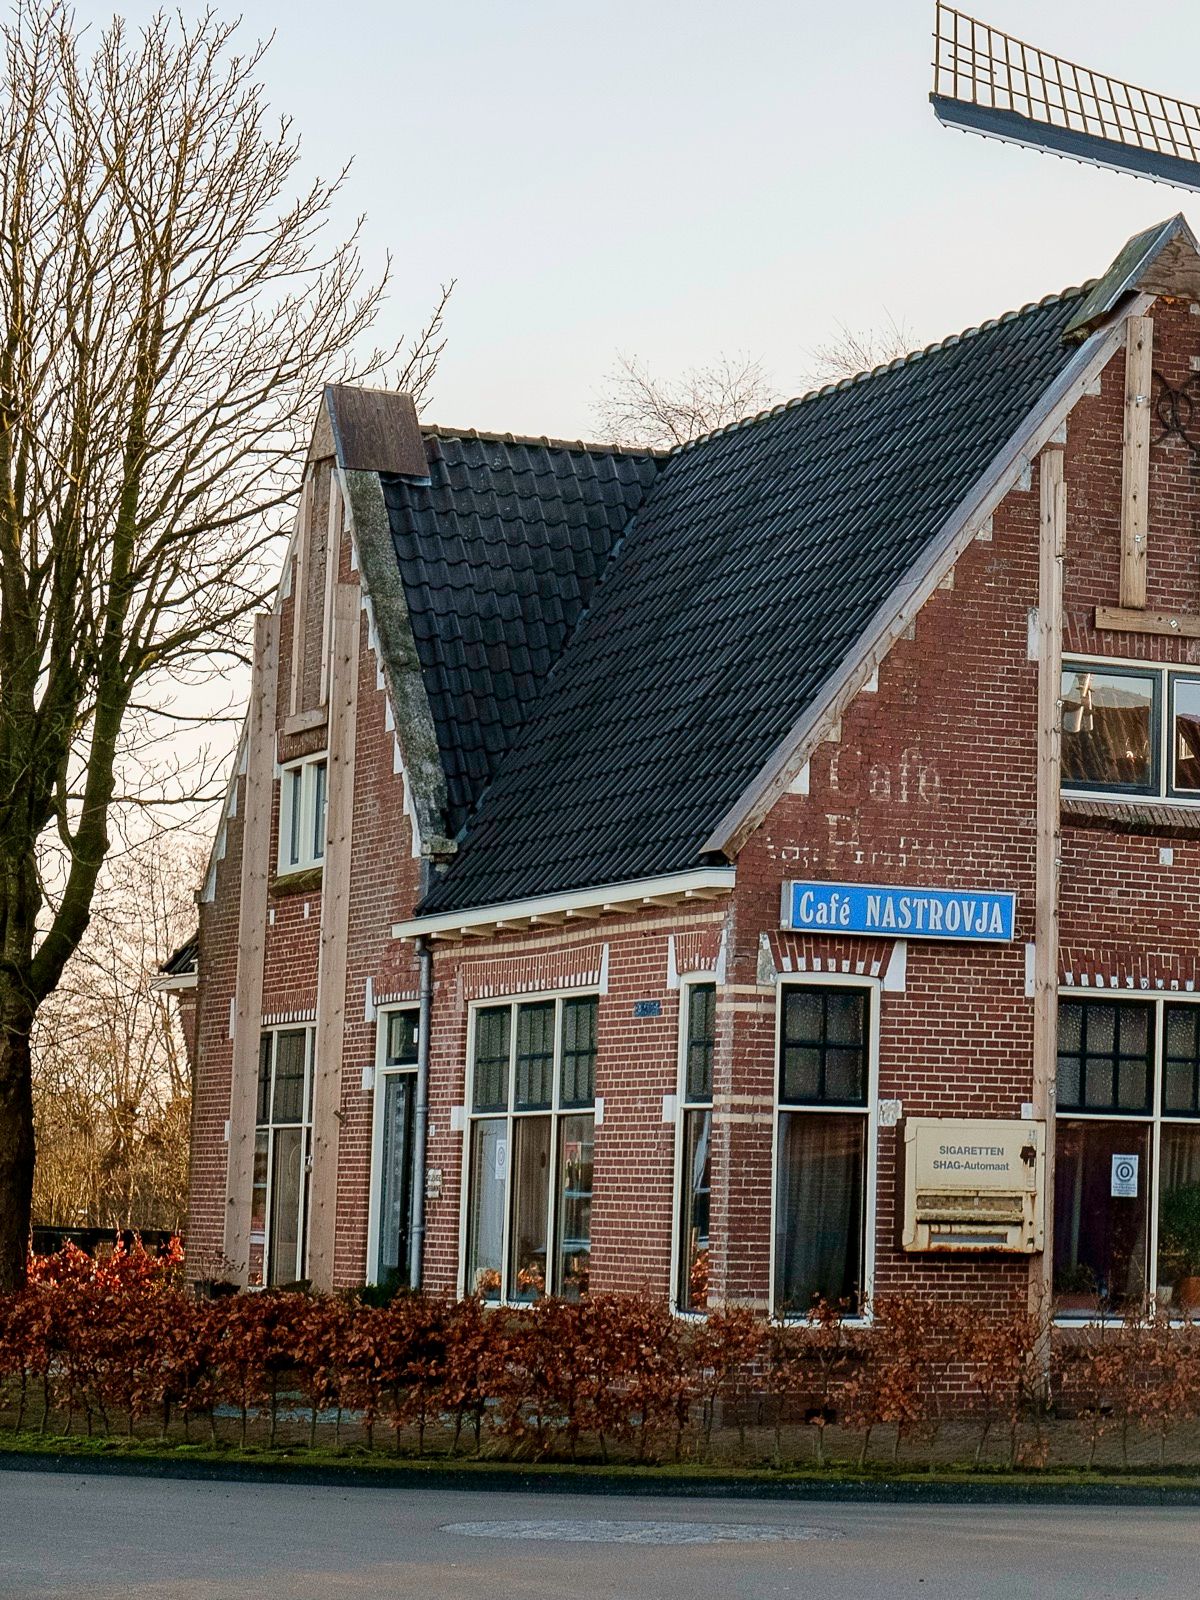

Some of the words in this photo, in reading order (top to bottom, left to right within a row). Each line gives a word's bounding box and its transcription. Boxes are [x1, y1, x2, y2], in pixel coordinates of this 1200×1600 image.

[800, 890, 851, 926] Café
[865, 895, 1004, 934] NASTROVJA
[939, 1145, 1005, 1156] SIGARETTEN
[932, 1160, 1010, 1171] SHAG-Automaat
